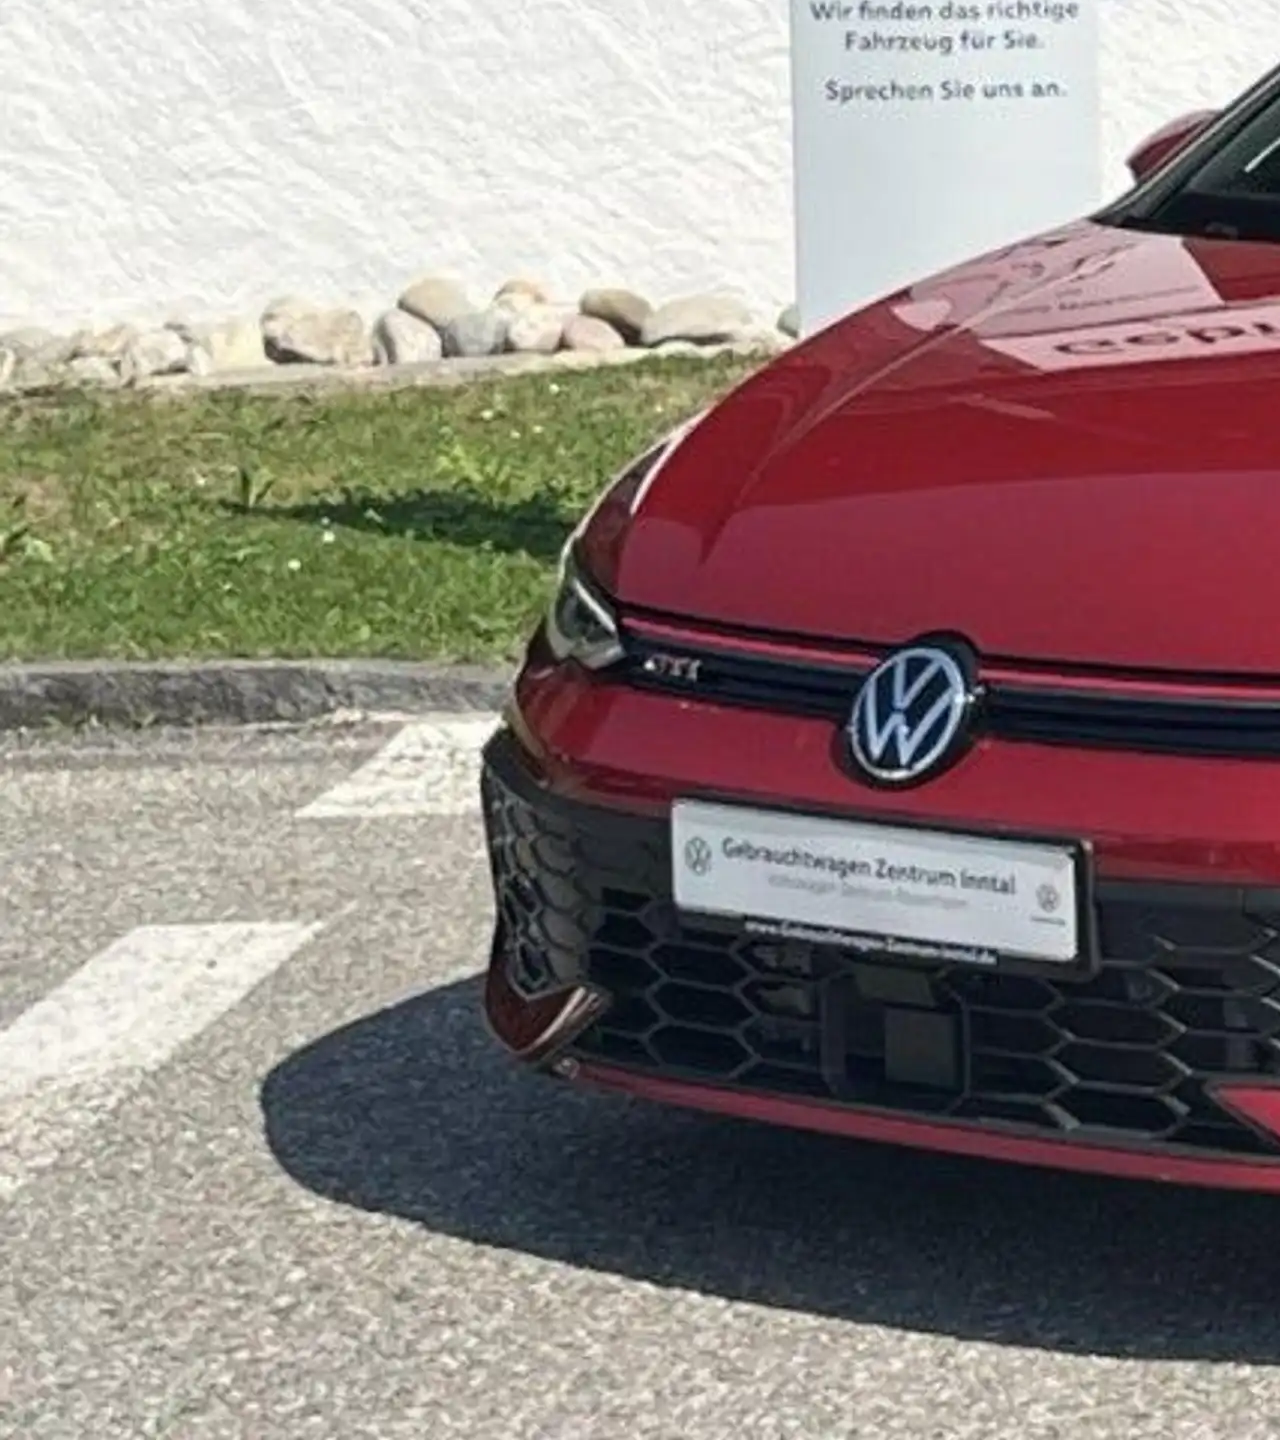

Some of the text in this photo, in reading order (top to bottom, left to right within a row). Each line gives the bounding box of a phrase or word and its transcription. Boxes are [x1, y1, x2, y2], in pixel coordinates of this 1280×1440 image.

[809, 0, 1081, 24] Wir finden das richtige
[844, 31, 954, 57] Fahrzeug
[960, 30, 996, 51] für
[824, 79, 935, 106] Sprechen
[940, 79, 976, 101] Sie
[983, 82, 1024, 101] uns
[848, 646, 967, 781] VW
[721, 835, 872, 881] Gebrauchtwagen
[875, 857, 958, 889] Zentrum
[959, 868, 1017, 896] Inntal
